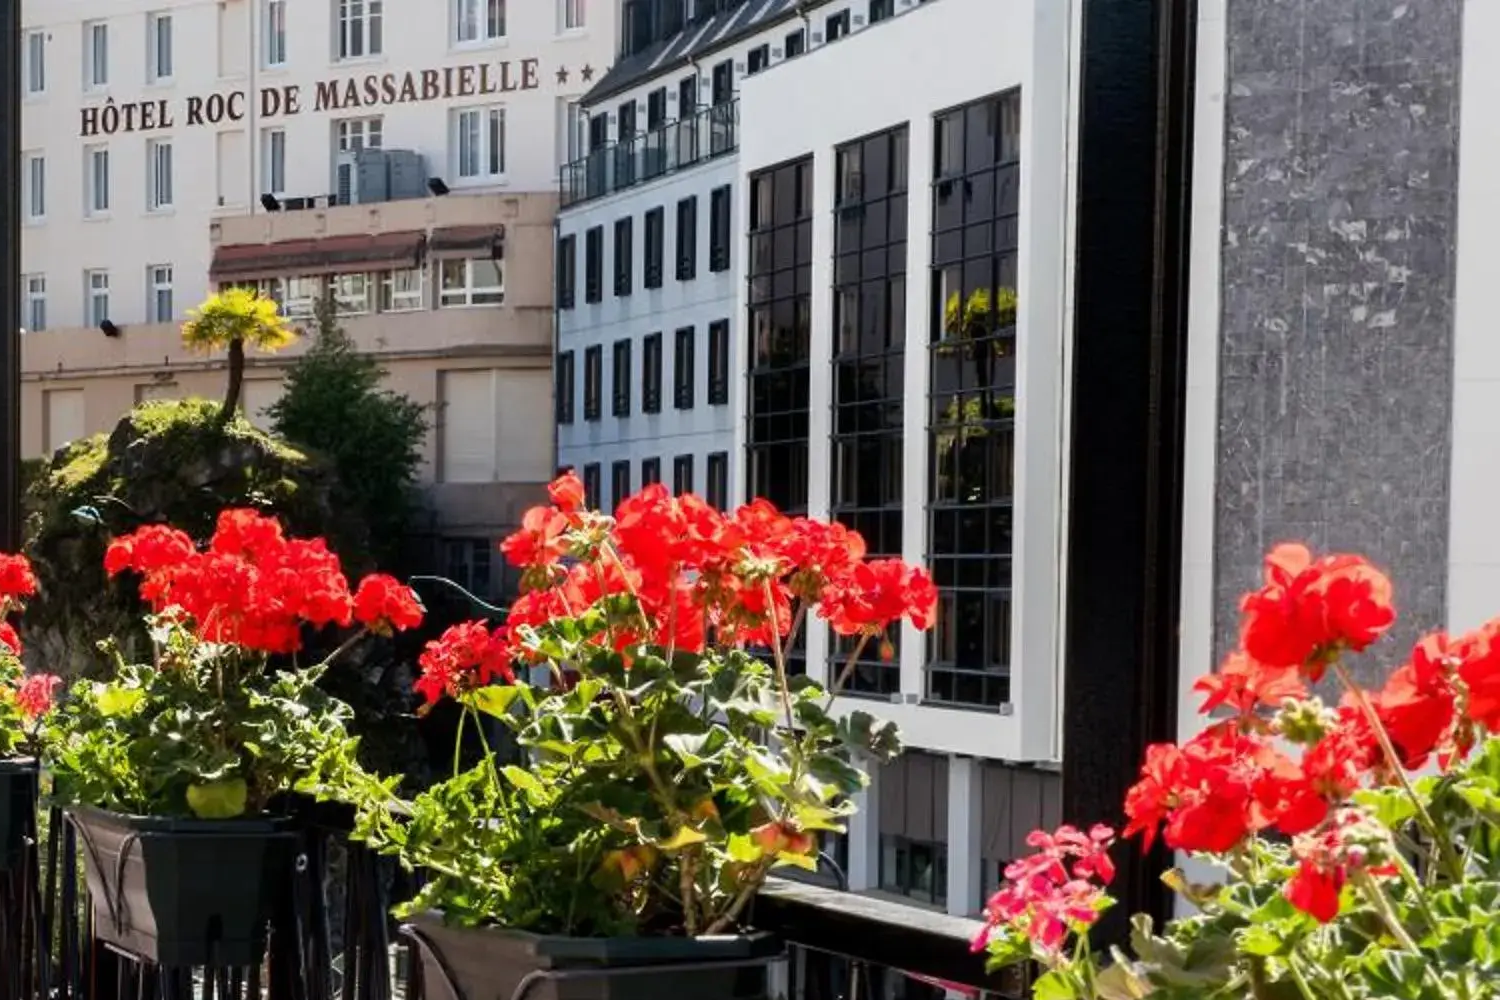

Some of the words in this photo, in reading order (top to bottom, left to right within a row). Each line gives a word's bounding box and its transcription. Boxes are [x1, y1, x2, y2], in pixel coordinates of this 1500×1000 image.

[80, 95, 173, 137] HÔTEL
[186, 90, 245, 126] ROC
[260, 84, 300, 118] DE
[313, 58, 540, 112] MASSABIELLE
